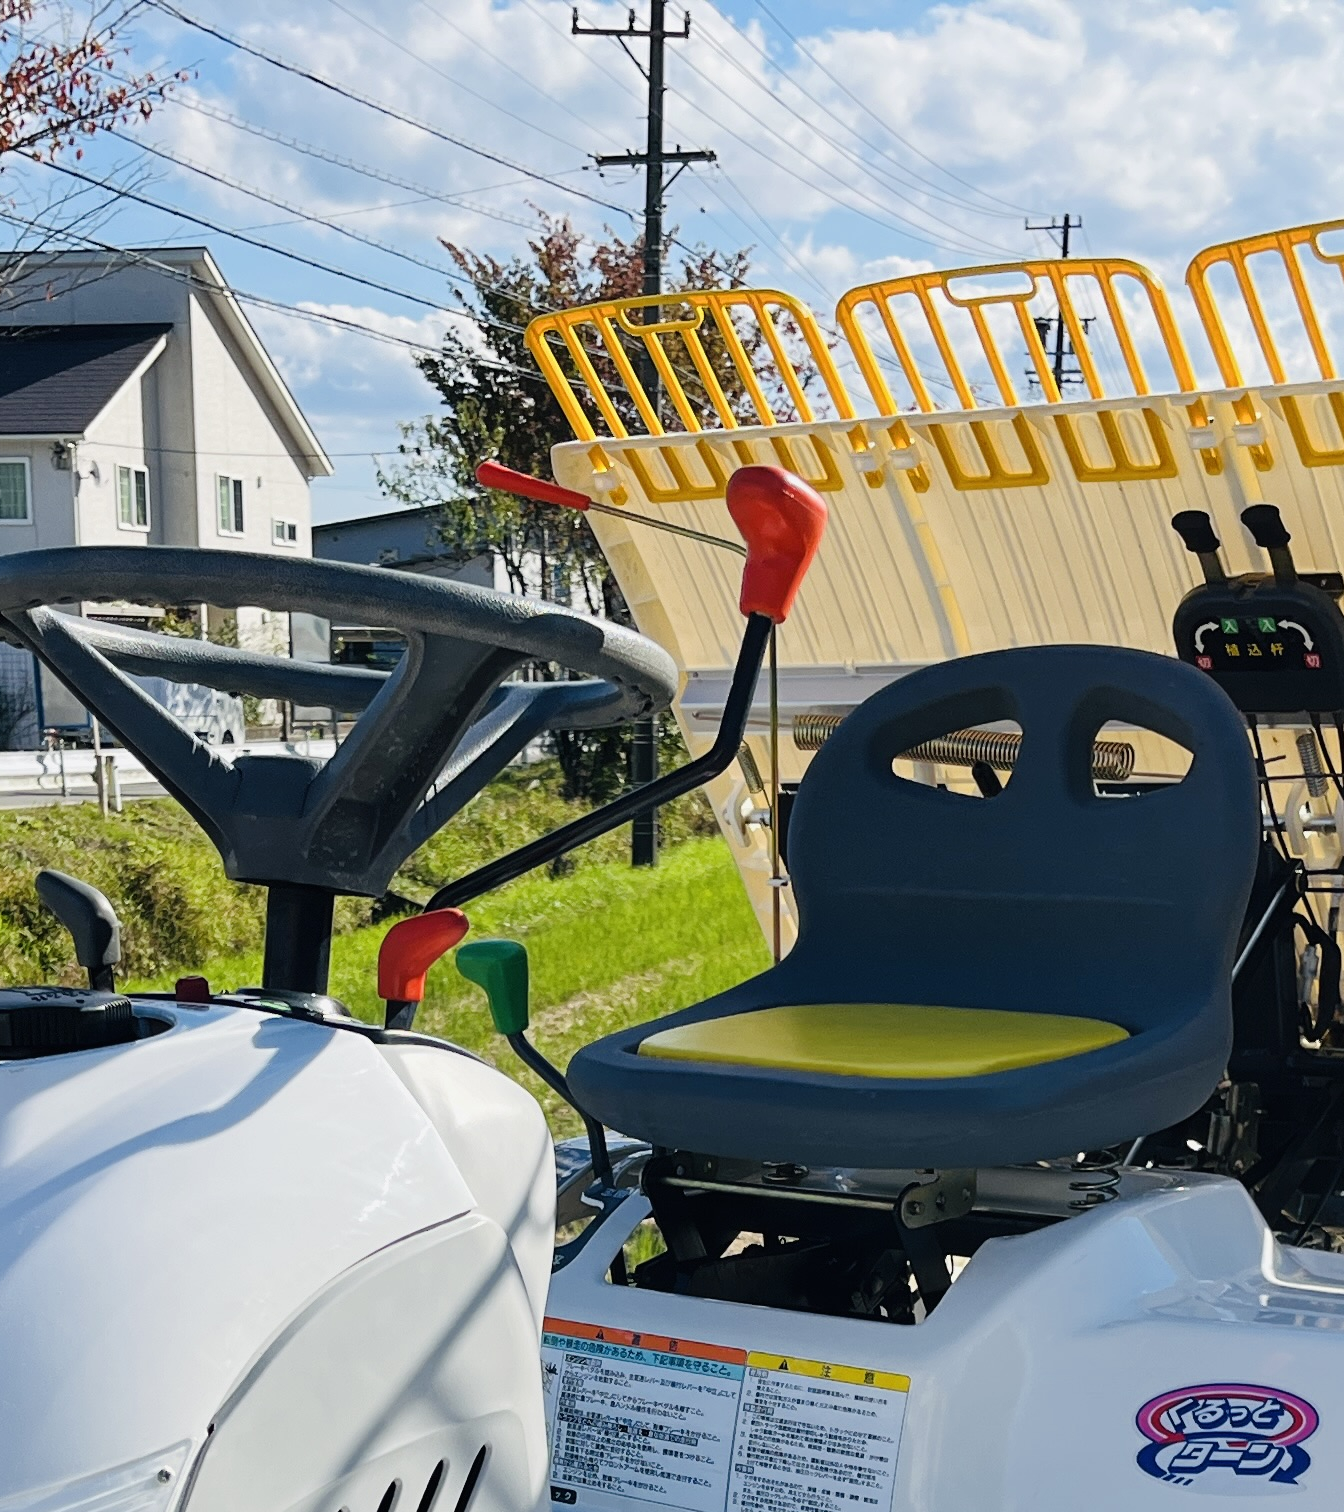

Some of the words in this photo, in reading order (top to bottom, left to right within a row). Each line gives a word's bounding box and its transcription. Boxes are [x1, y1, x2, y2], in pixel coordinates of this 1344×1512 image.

[1223, 620, 1238, 633] 入
[1261, 619, 1276, 632] 入
[1165, 1397, 1287, 1431] くるっと
[1167, 1440, 1288, 1475] ターン
